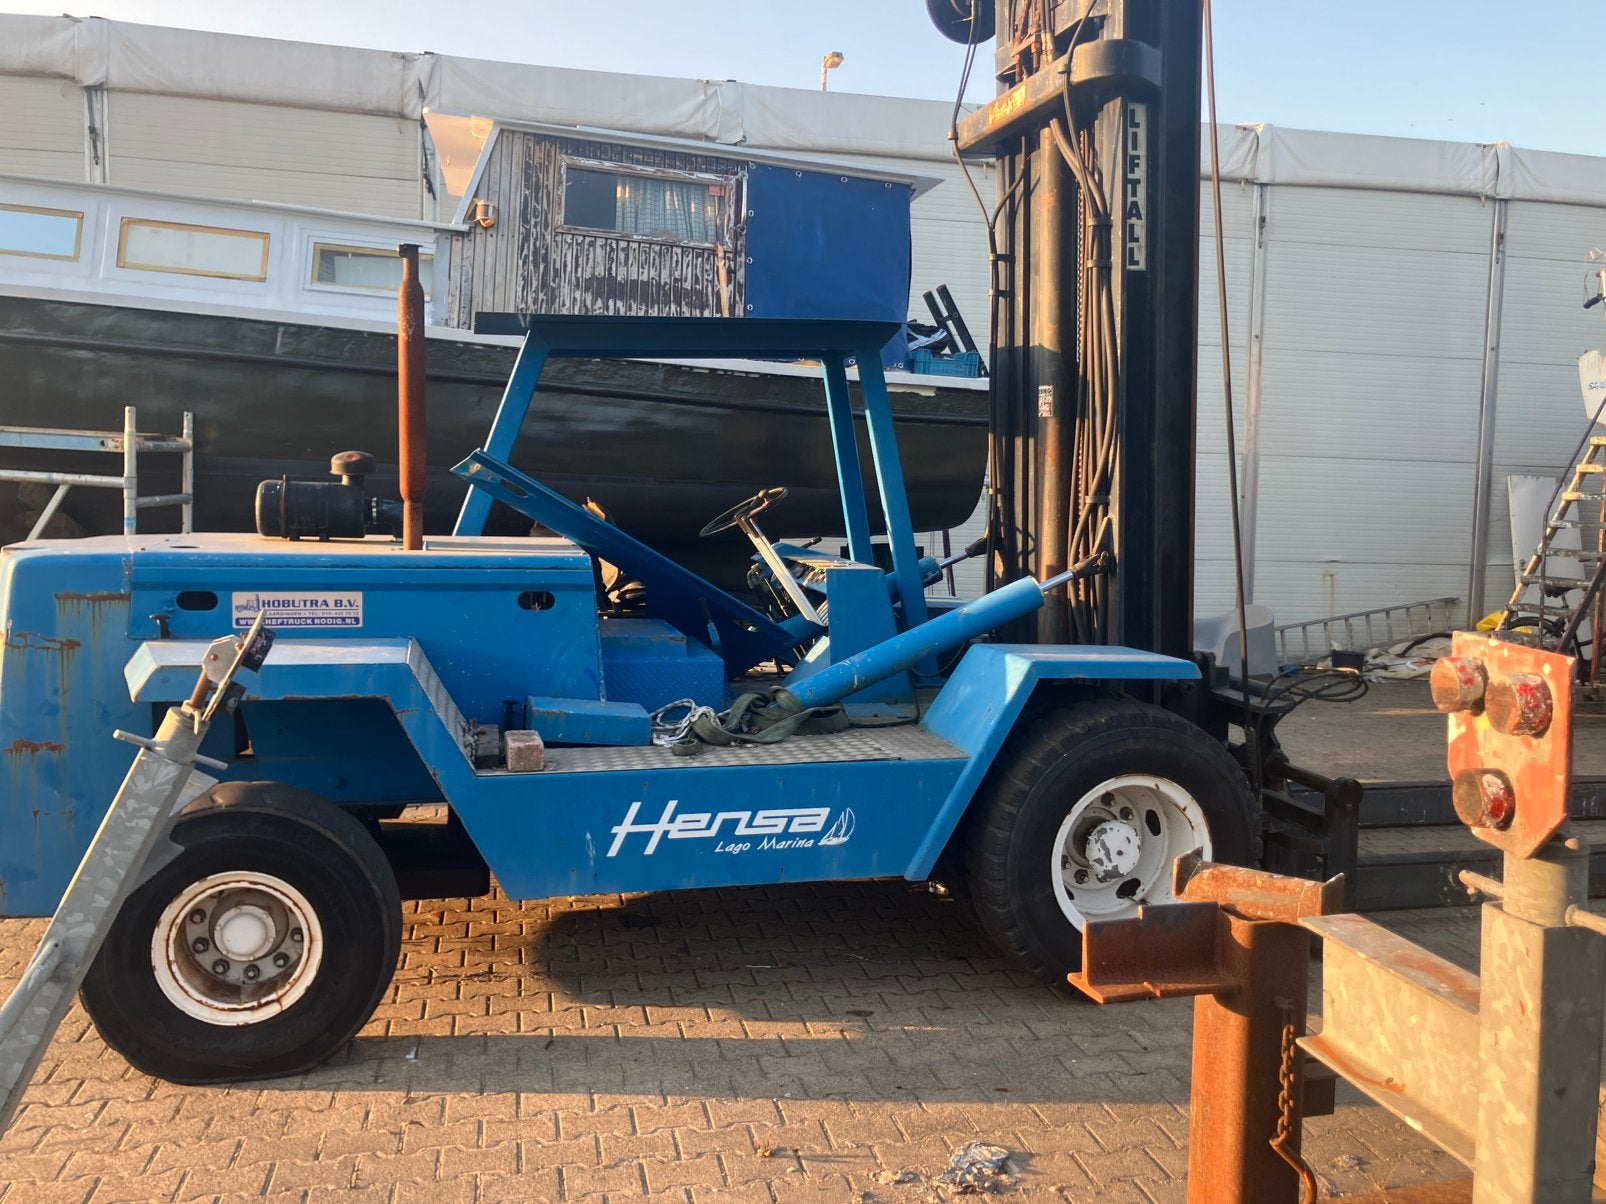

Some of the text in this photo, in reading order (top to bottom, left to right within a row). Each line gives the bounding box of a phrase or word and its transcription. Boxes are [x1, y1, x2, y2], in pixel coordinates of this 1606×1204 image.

[1127, 108, 1142, 266] LIFTALL
[262, 599, 359, 608] HOBUTRA B.V.
[606, 800, 831, 857] Hensa
[714, 836, 814, 855] Lago Marina
